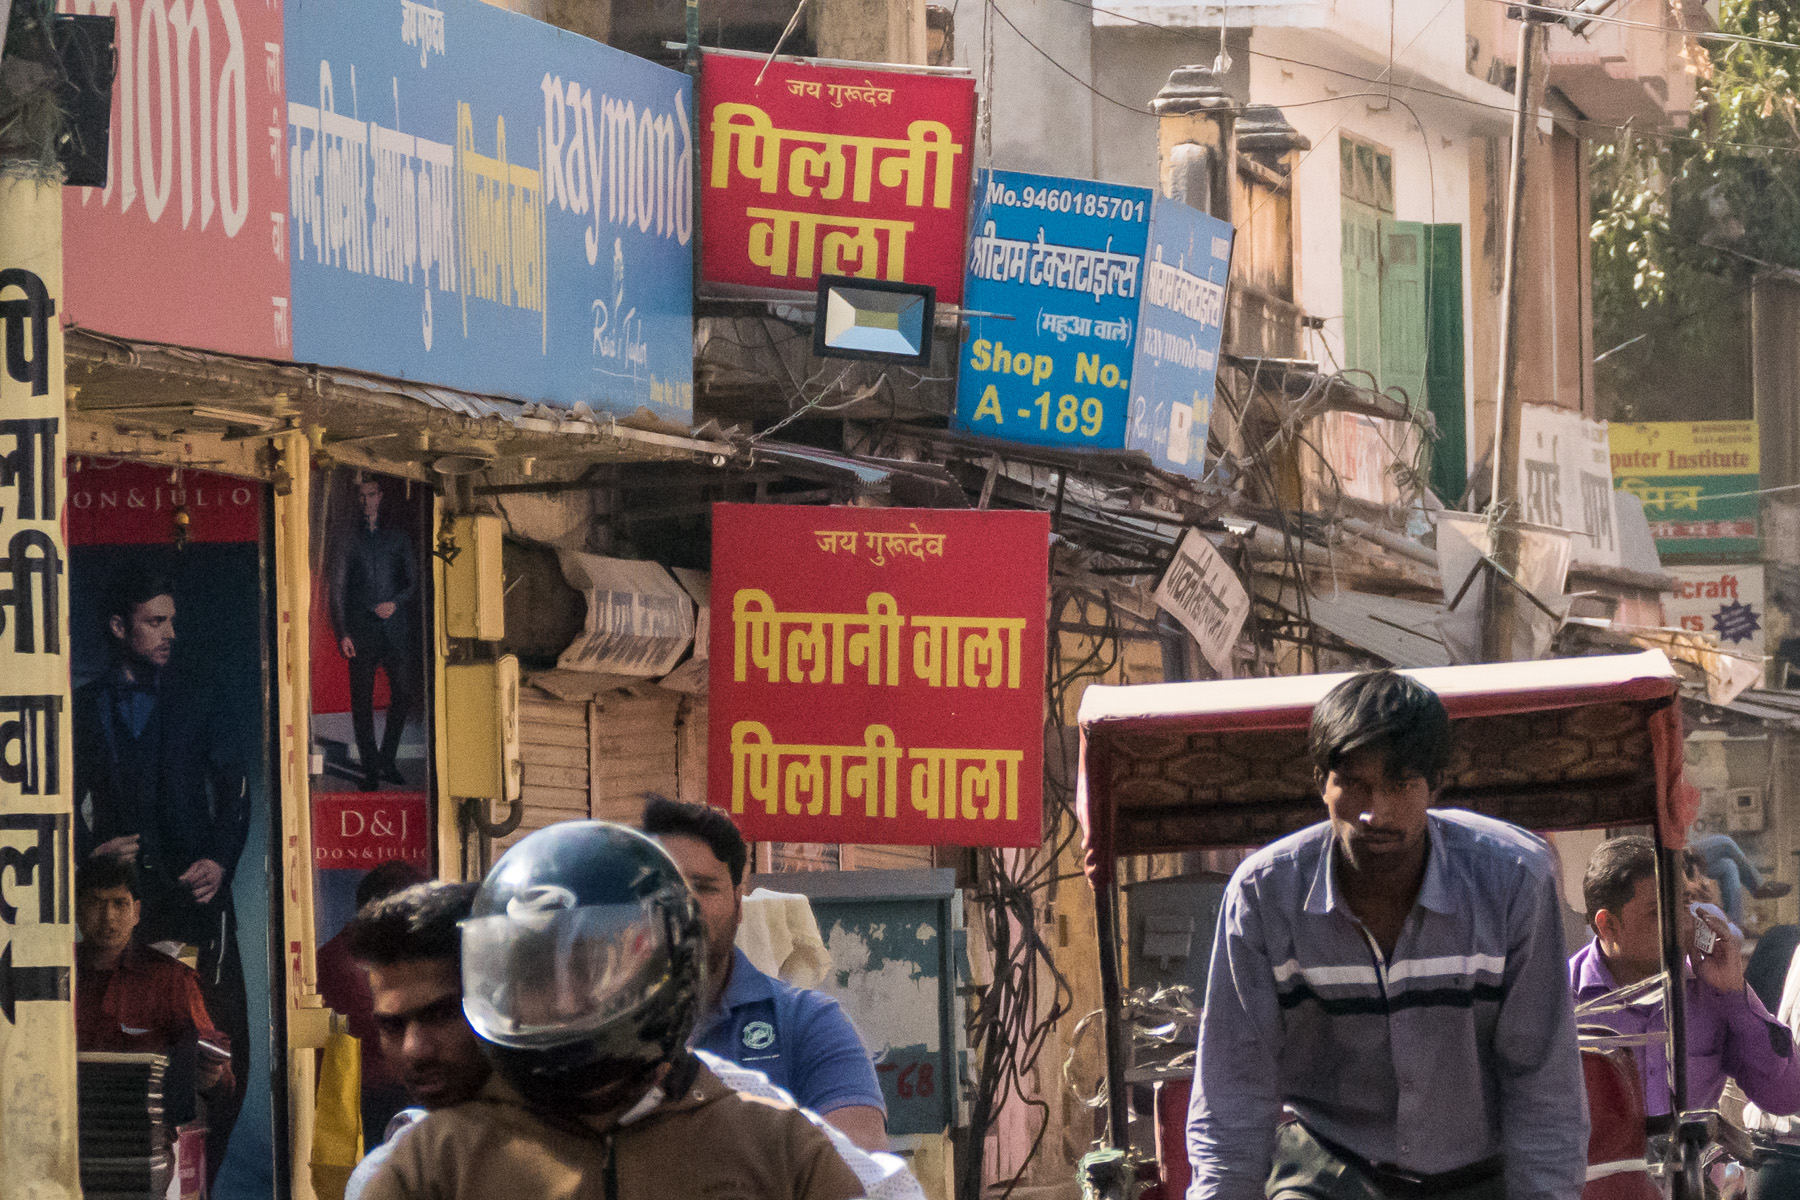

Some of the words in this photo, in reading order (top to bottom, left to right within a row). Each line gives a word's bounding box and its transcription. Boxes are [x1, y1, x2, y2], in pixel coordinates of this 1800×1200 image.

[786, 79, 822, 98] जय
[541, 72, 692, 266] Raymond
[710, 102, 962, 209] पिलानी
[986, 181, 1145, 223] Mo.9460185701
[746, 207, 914, 284] वाला
[970, 220, 1030, 284] श्रीराम
[971, 340, 1054, 384] Shop
[1075, 352, 1128, 390] No.
[973, 384, 1003, 424] A
[1018, 393, 1104, 436] -189
[1610, 450, 1661, 473] puter
[1668, 448, 1749, 470] Institute
[72, 487, 252, 512] ON&JULIO
[815, 530, 857, 555] जय
[1672, 574, 1739, 600] icraft
[732, 588, 904, 686] पिलानी
[911, 615, 1026, 689] वाला
[730, 720, 902, 818] पिलानी
[909, 747, 1023, 820] वाला
[341, 809, 408, 841] D&J
